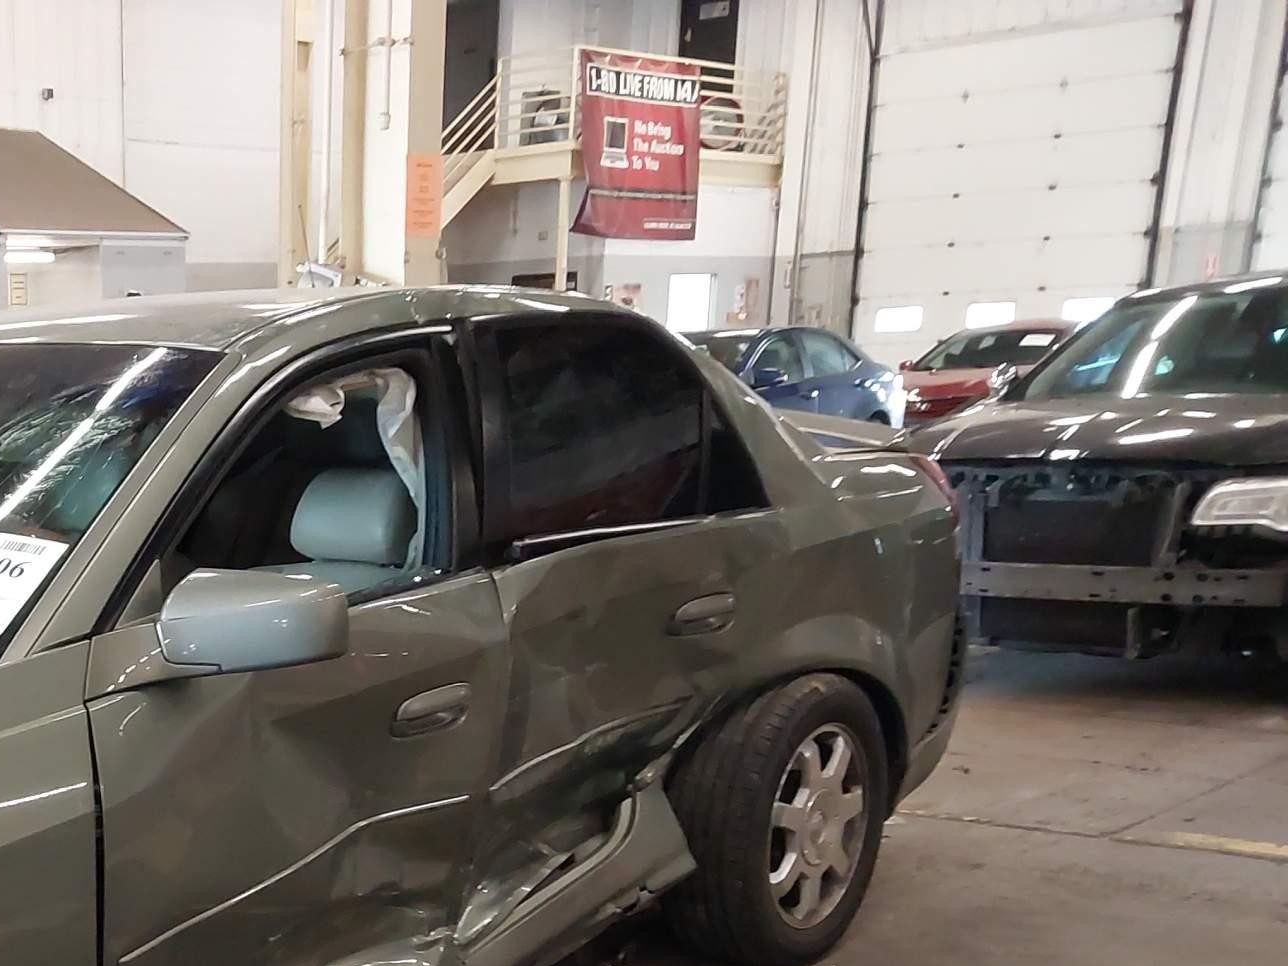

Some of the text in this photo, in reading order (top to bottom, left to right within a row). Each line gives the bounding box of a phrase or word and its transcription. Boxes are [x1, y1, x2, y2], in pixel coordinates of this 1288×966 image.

[619, 71, 642, 97] LIVE
[643, 75, 675, 101] FROM
[633, 137, 649, 152] The
[631, 155, 660, 172] To You
